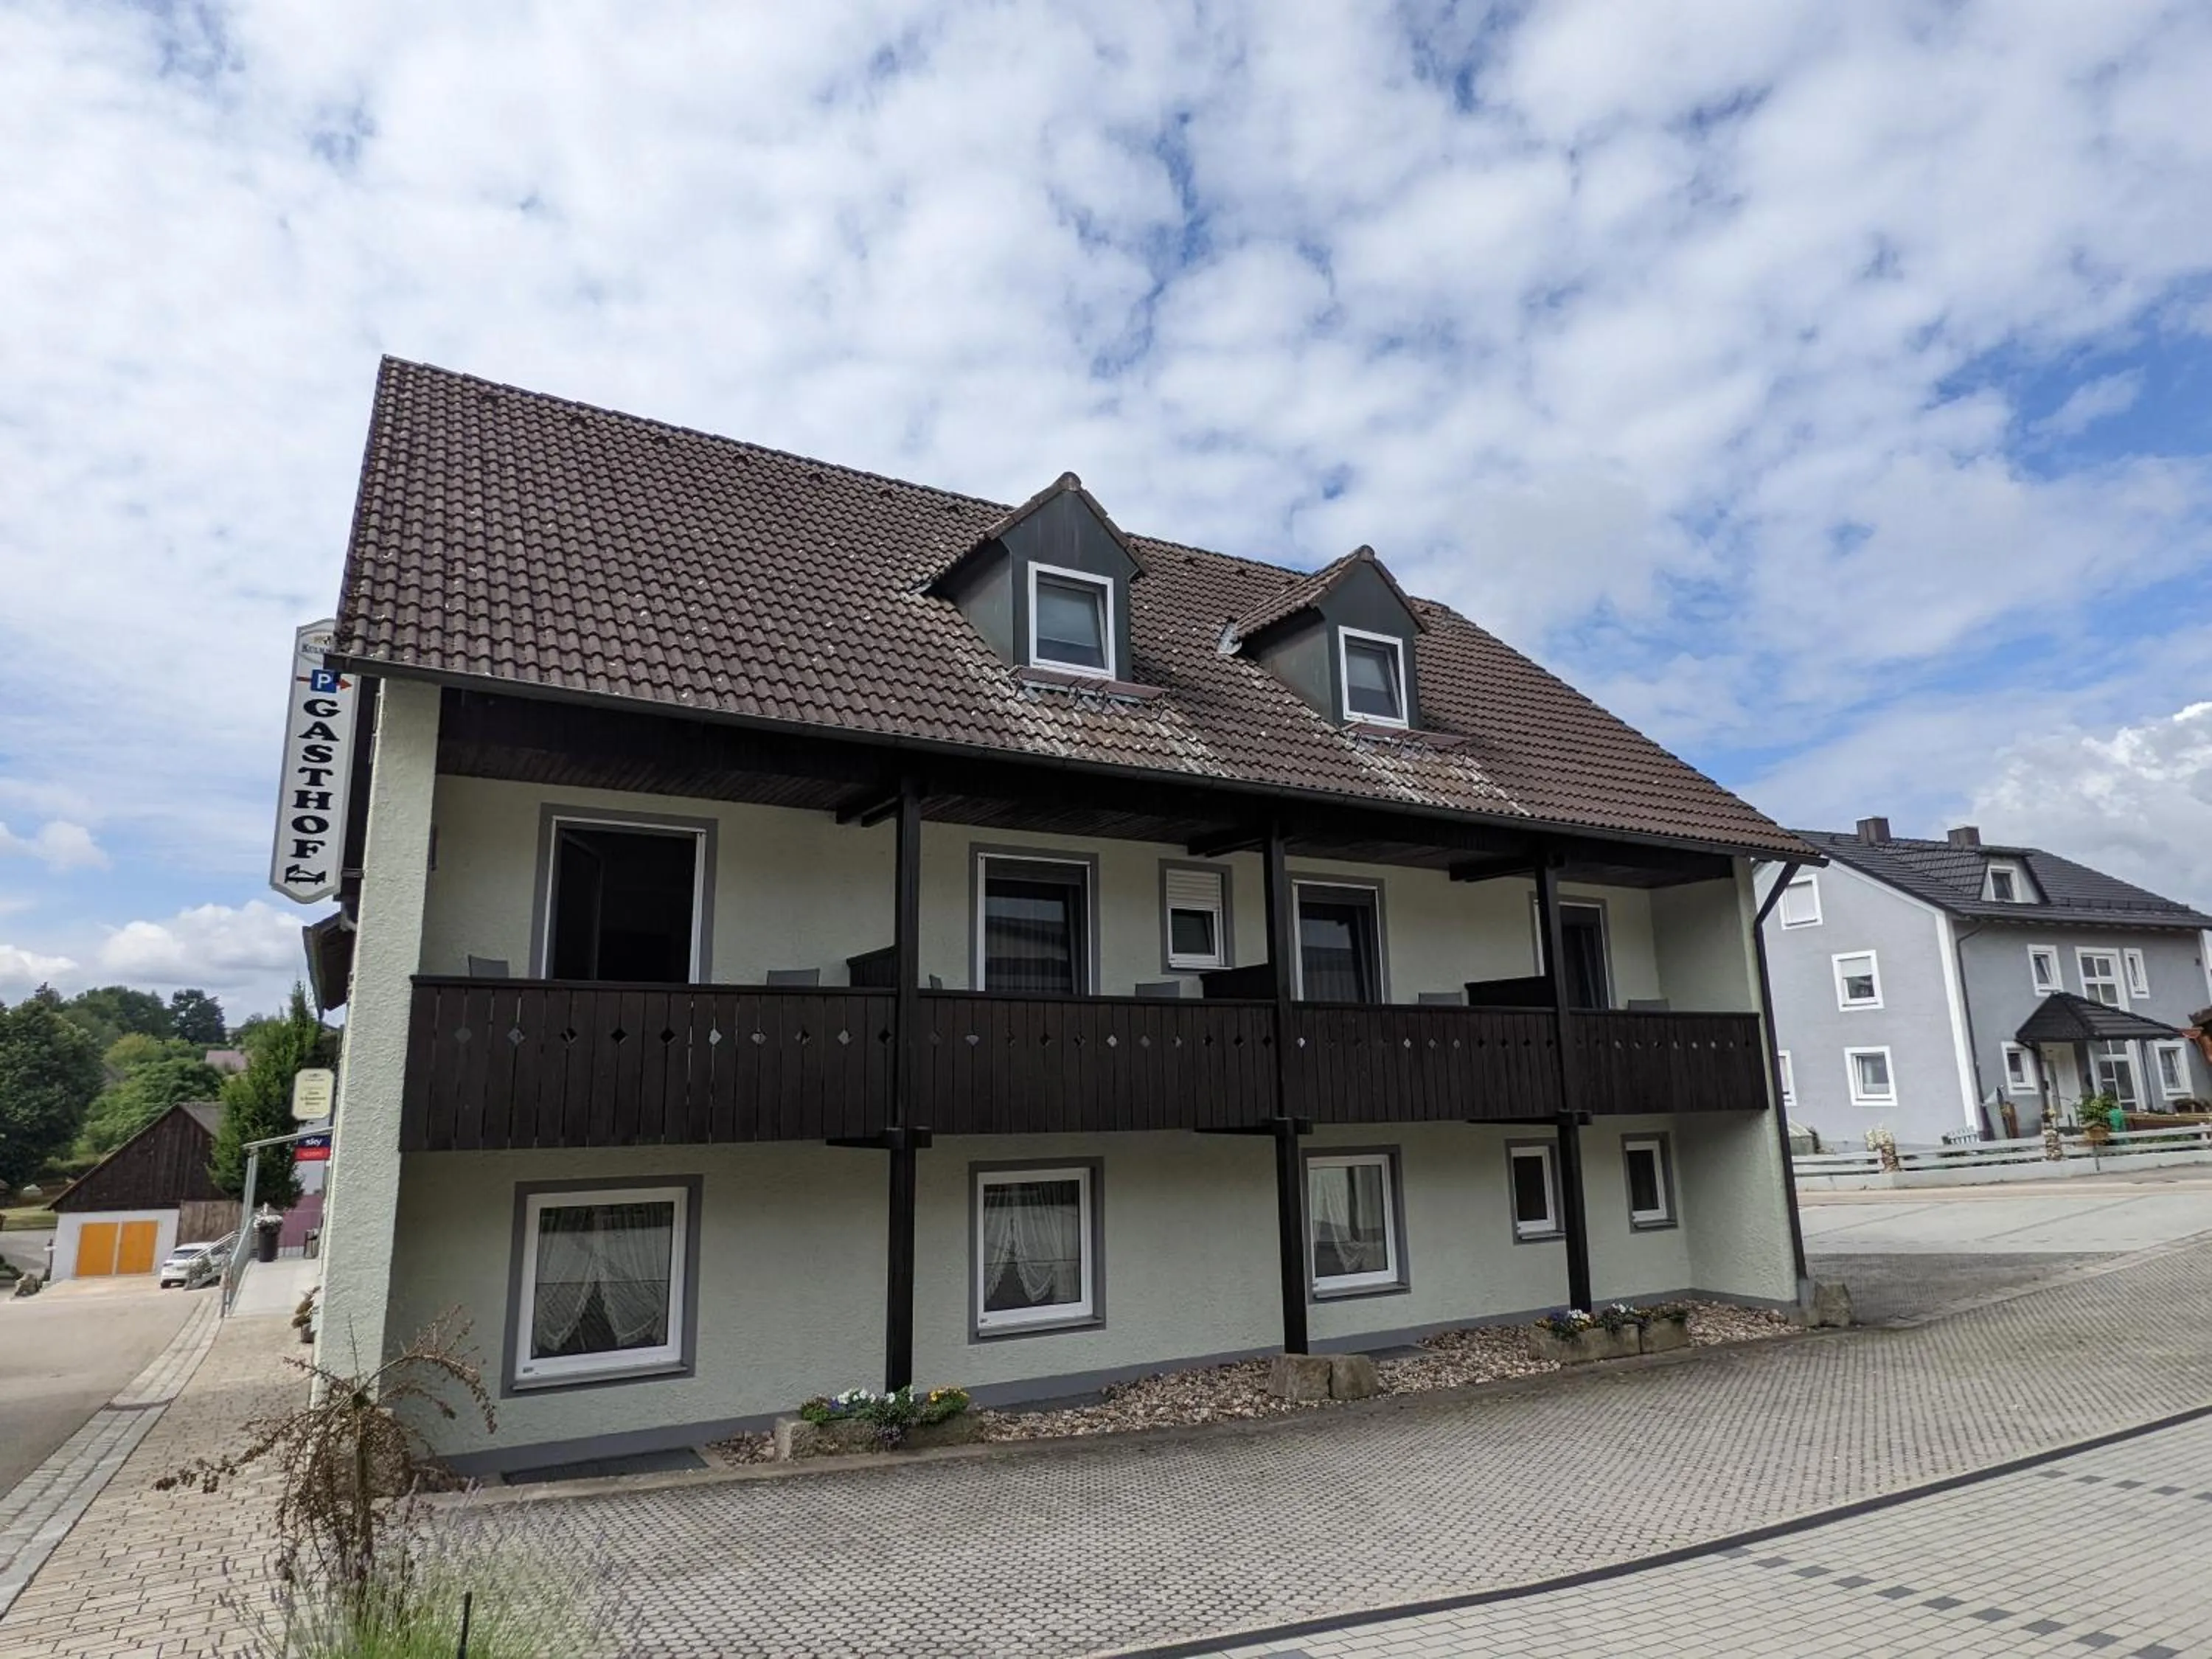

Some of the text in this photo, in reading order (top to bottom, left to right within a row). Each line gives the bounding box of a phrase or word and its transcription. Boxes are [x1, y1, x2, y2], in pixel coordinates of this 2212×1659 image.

[317, 674, 332, 689] P
[289, 698, 341, 859] GASTHOF
[305, 1137, 322, 1147] sky
